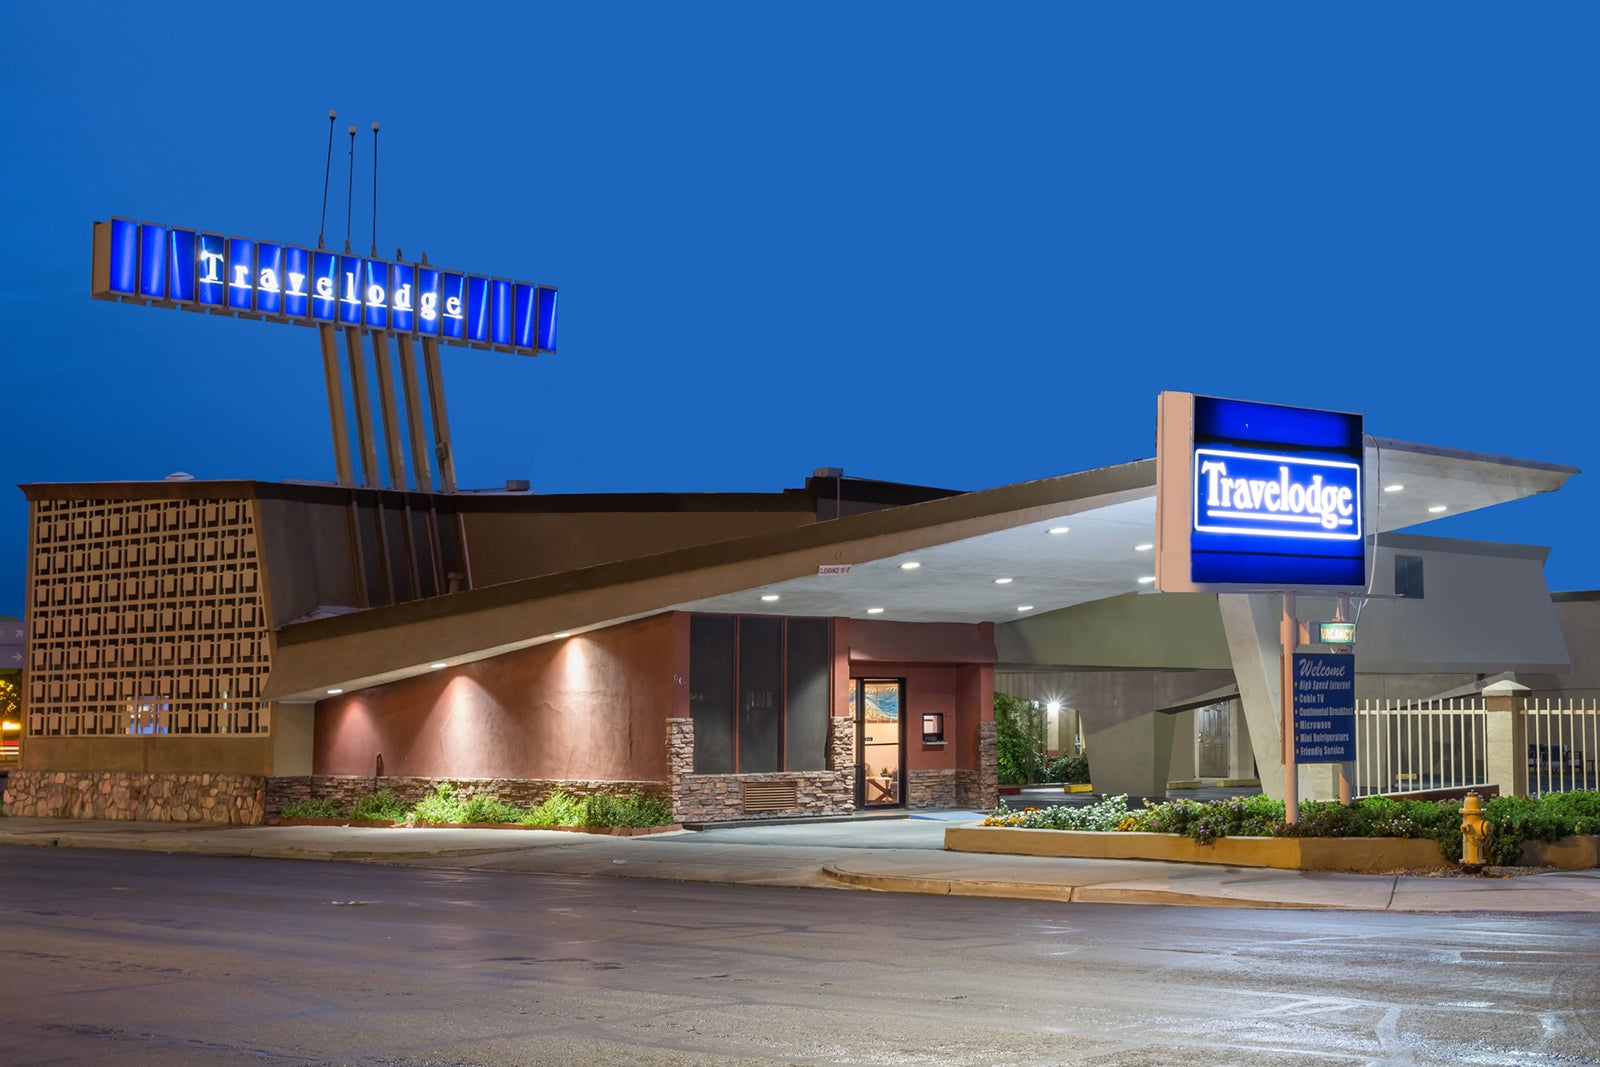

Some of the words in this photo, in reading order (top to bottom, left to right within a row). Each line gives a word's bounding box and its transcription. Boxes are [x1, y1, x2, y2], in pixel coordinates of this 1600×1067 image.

[200, 250, 463, 321] Travelodge
[1201, 460, 1353, 529] Travelodge
[1320, 627, 1354, 641] VACANCY
[1299, 658, 1345, 677] Welcome
[1299, 680, 1312, 691] High
[1312, 680, 1329, 690] Speed
[1329, 680, 1351, 690] Internet
[1299, 694, 1316, 703] Cable
[1316, 694, 1324, 703] TV
[1299, 707, 1329, 717] Continental
[1299, 720, 1331, 730] Microwave
[1300, 733, 1312, 743] Mini
[1313, 733, 1349, 743] Refrigerators
[1300, 746, 1323, 756] Friendly
[1323, 746, 1345, 755] Service
